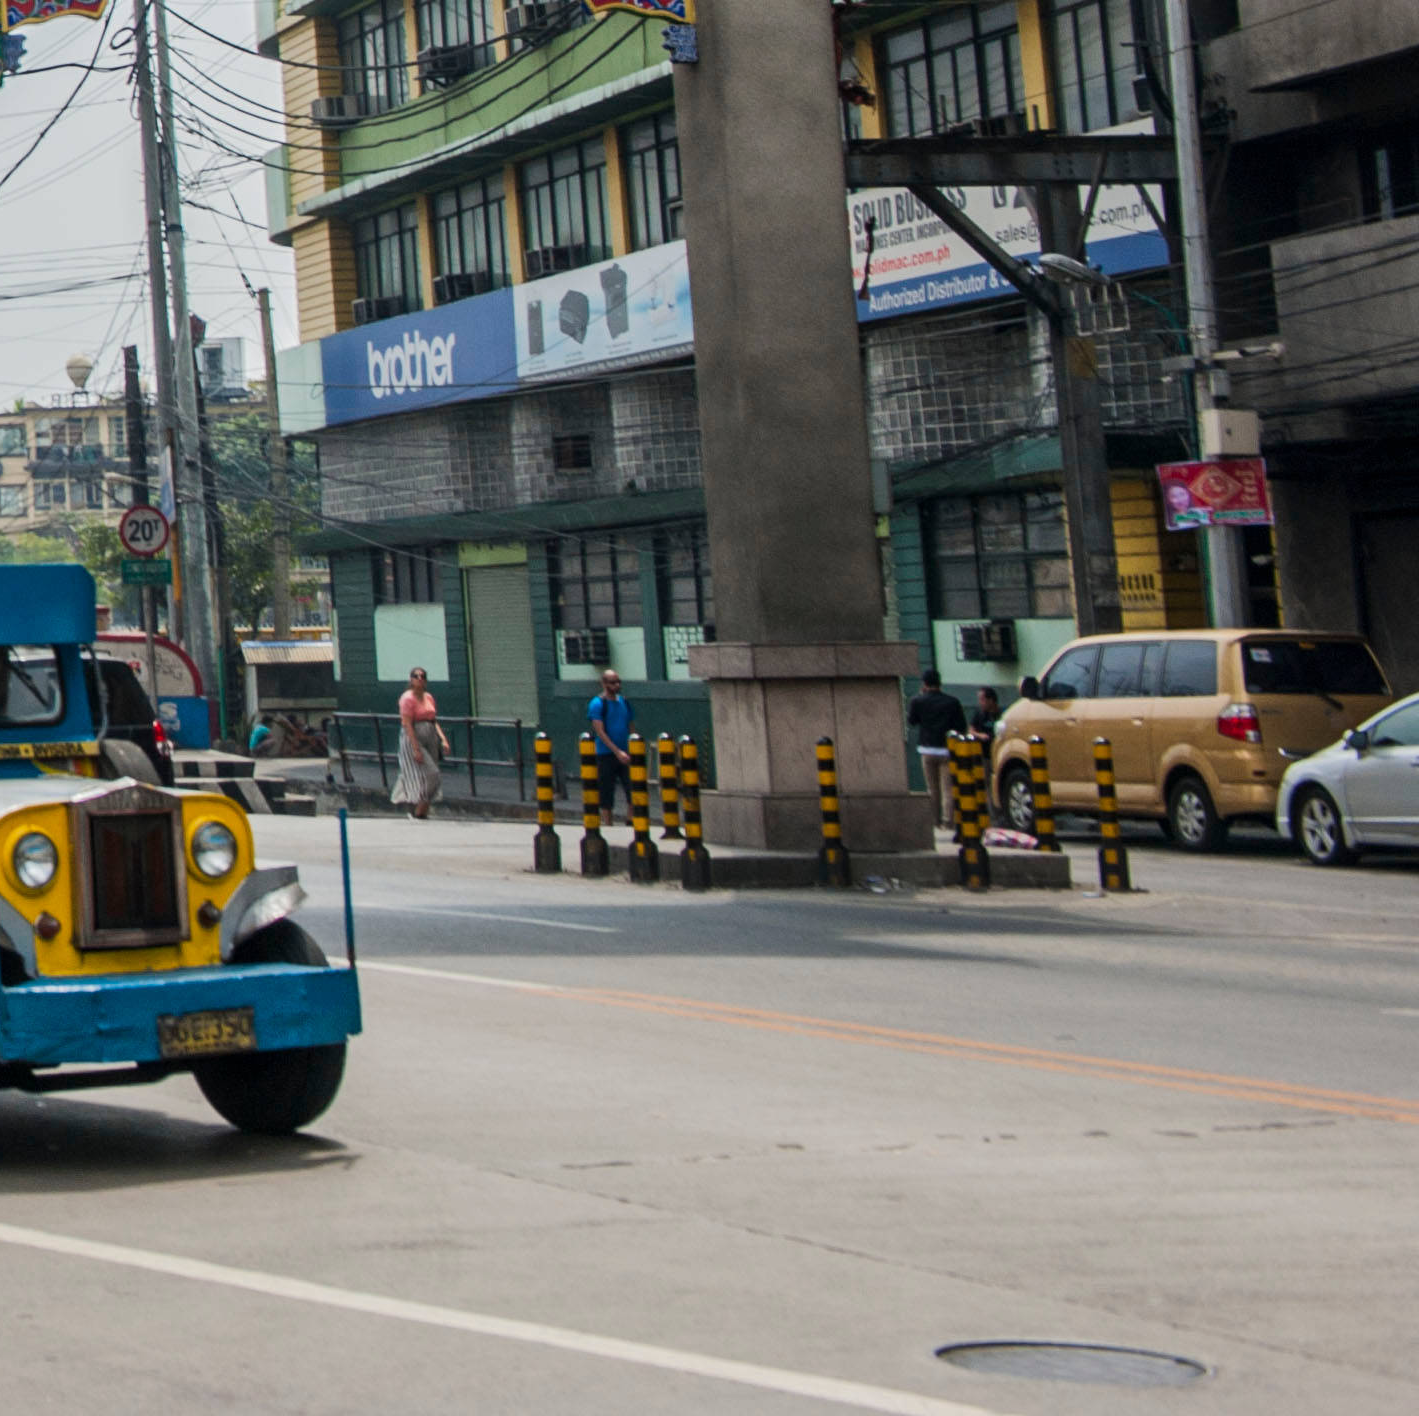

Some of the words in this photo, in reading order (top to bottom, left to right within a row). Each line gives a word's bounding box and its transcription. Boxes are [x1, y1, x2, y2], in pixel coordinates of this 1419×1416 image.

[853, 197, 892, 235] SOLID
[895, 186, 967, 226] BUSSS
[869, 284, 925, 312] Authorized
[927, 274, 987, 301] Distributor
[367, 330, 455, 399] brother
